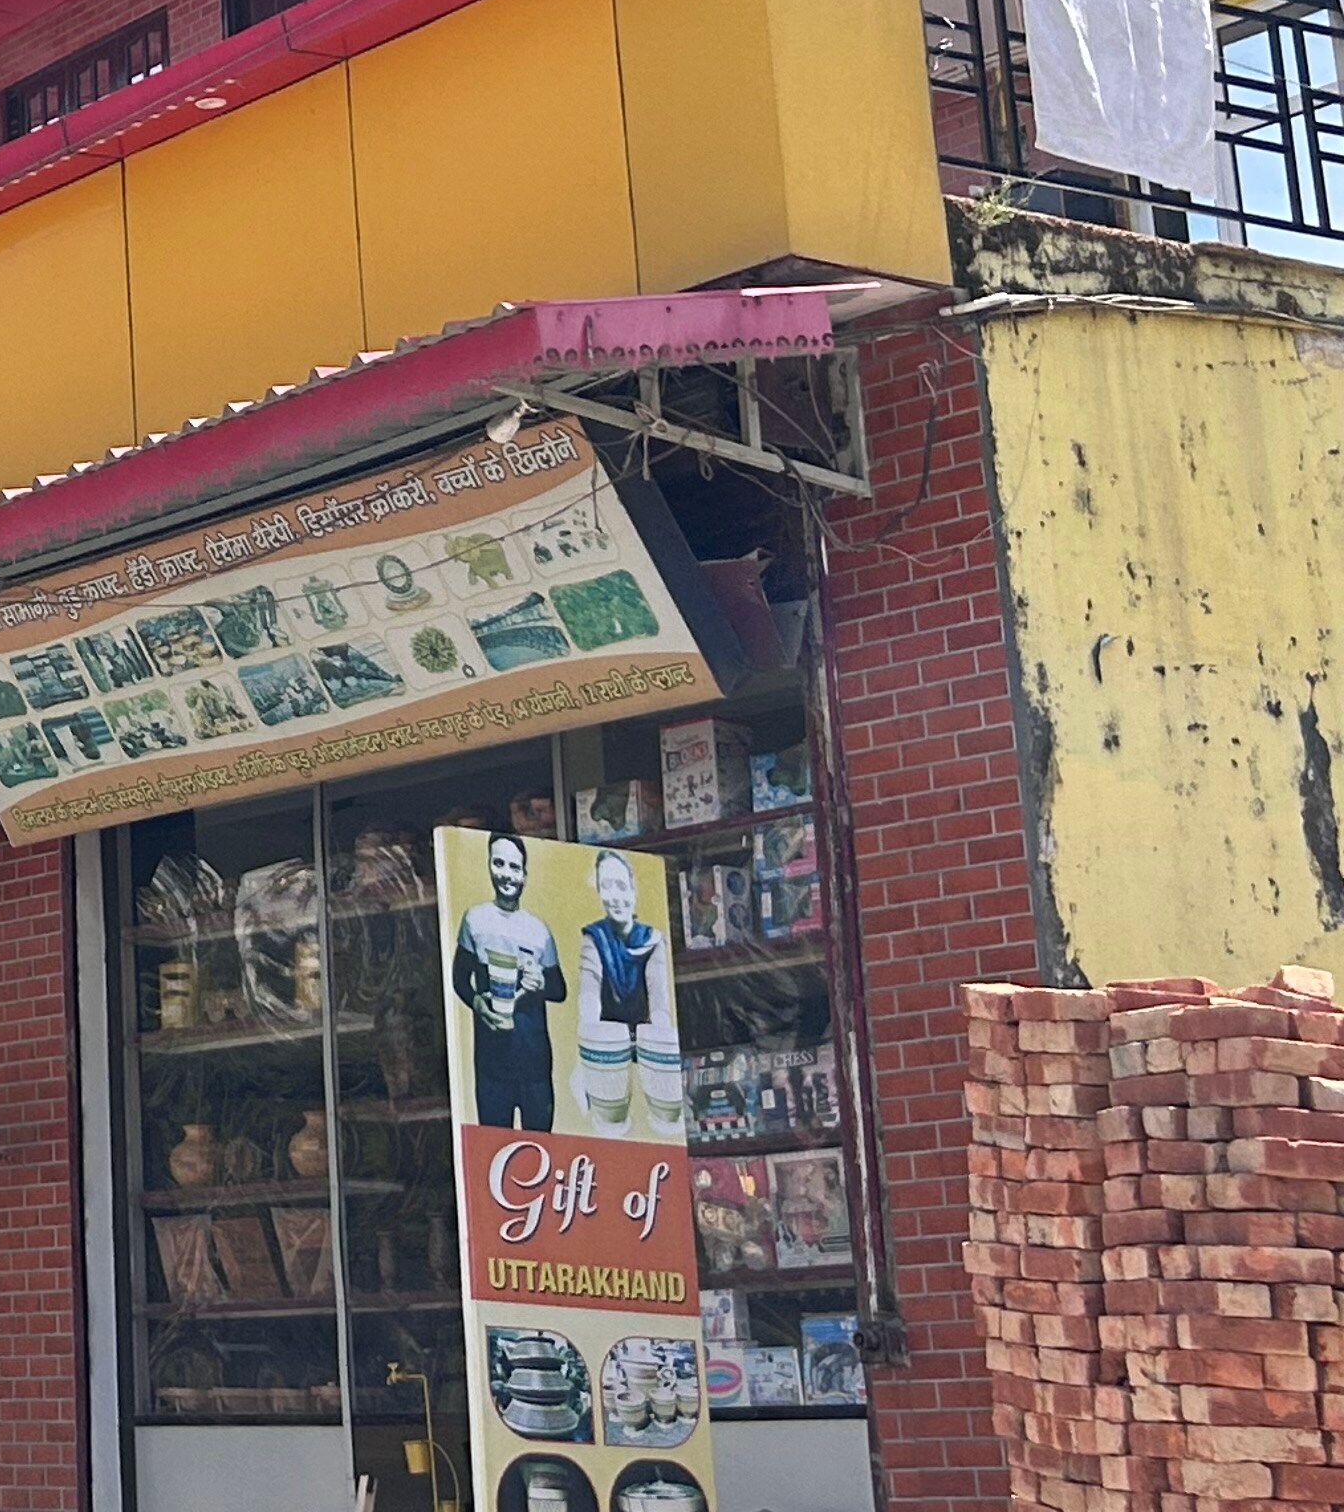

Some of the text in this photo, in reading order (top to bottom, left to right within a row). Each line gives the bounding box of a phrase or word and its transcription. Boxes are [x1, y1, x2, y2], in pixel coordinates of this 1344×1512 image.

[436, 457, 481, 493] बच्चों
[482, 450, 506, 481] के
[774, 1051, 814, 1068] CHESS
[488, 1140, 670, 1242] Gift of
[487, 1258, 687, 1304] UTTARAKHAND
